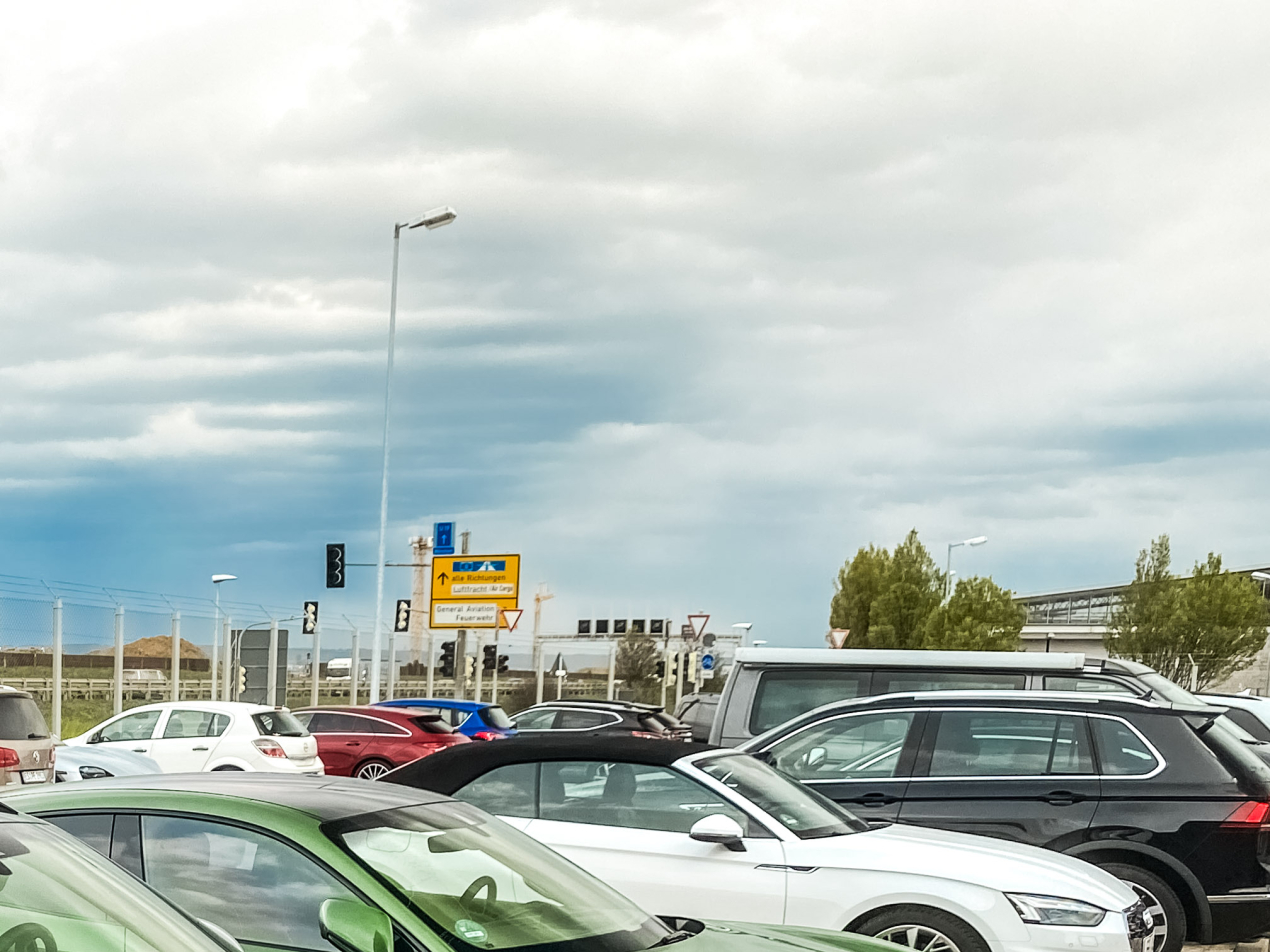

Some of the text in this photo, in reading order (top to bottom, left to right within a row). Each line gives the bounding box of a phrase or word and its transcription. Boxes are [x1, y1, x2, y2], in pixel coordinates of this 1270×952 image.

[467, 574, 506, 582] Richtungen
[453, 585, 488, 593] Luftfracht
[436, 605, 464, 613] General
